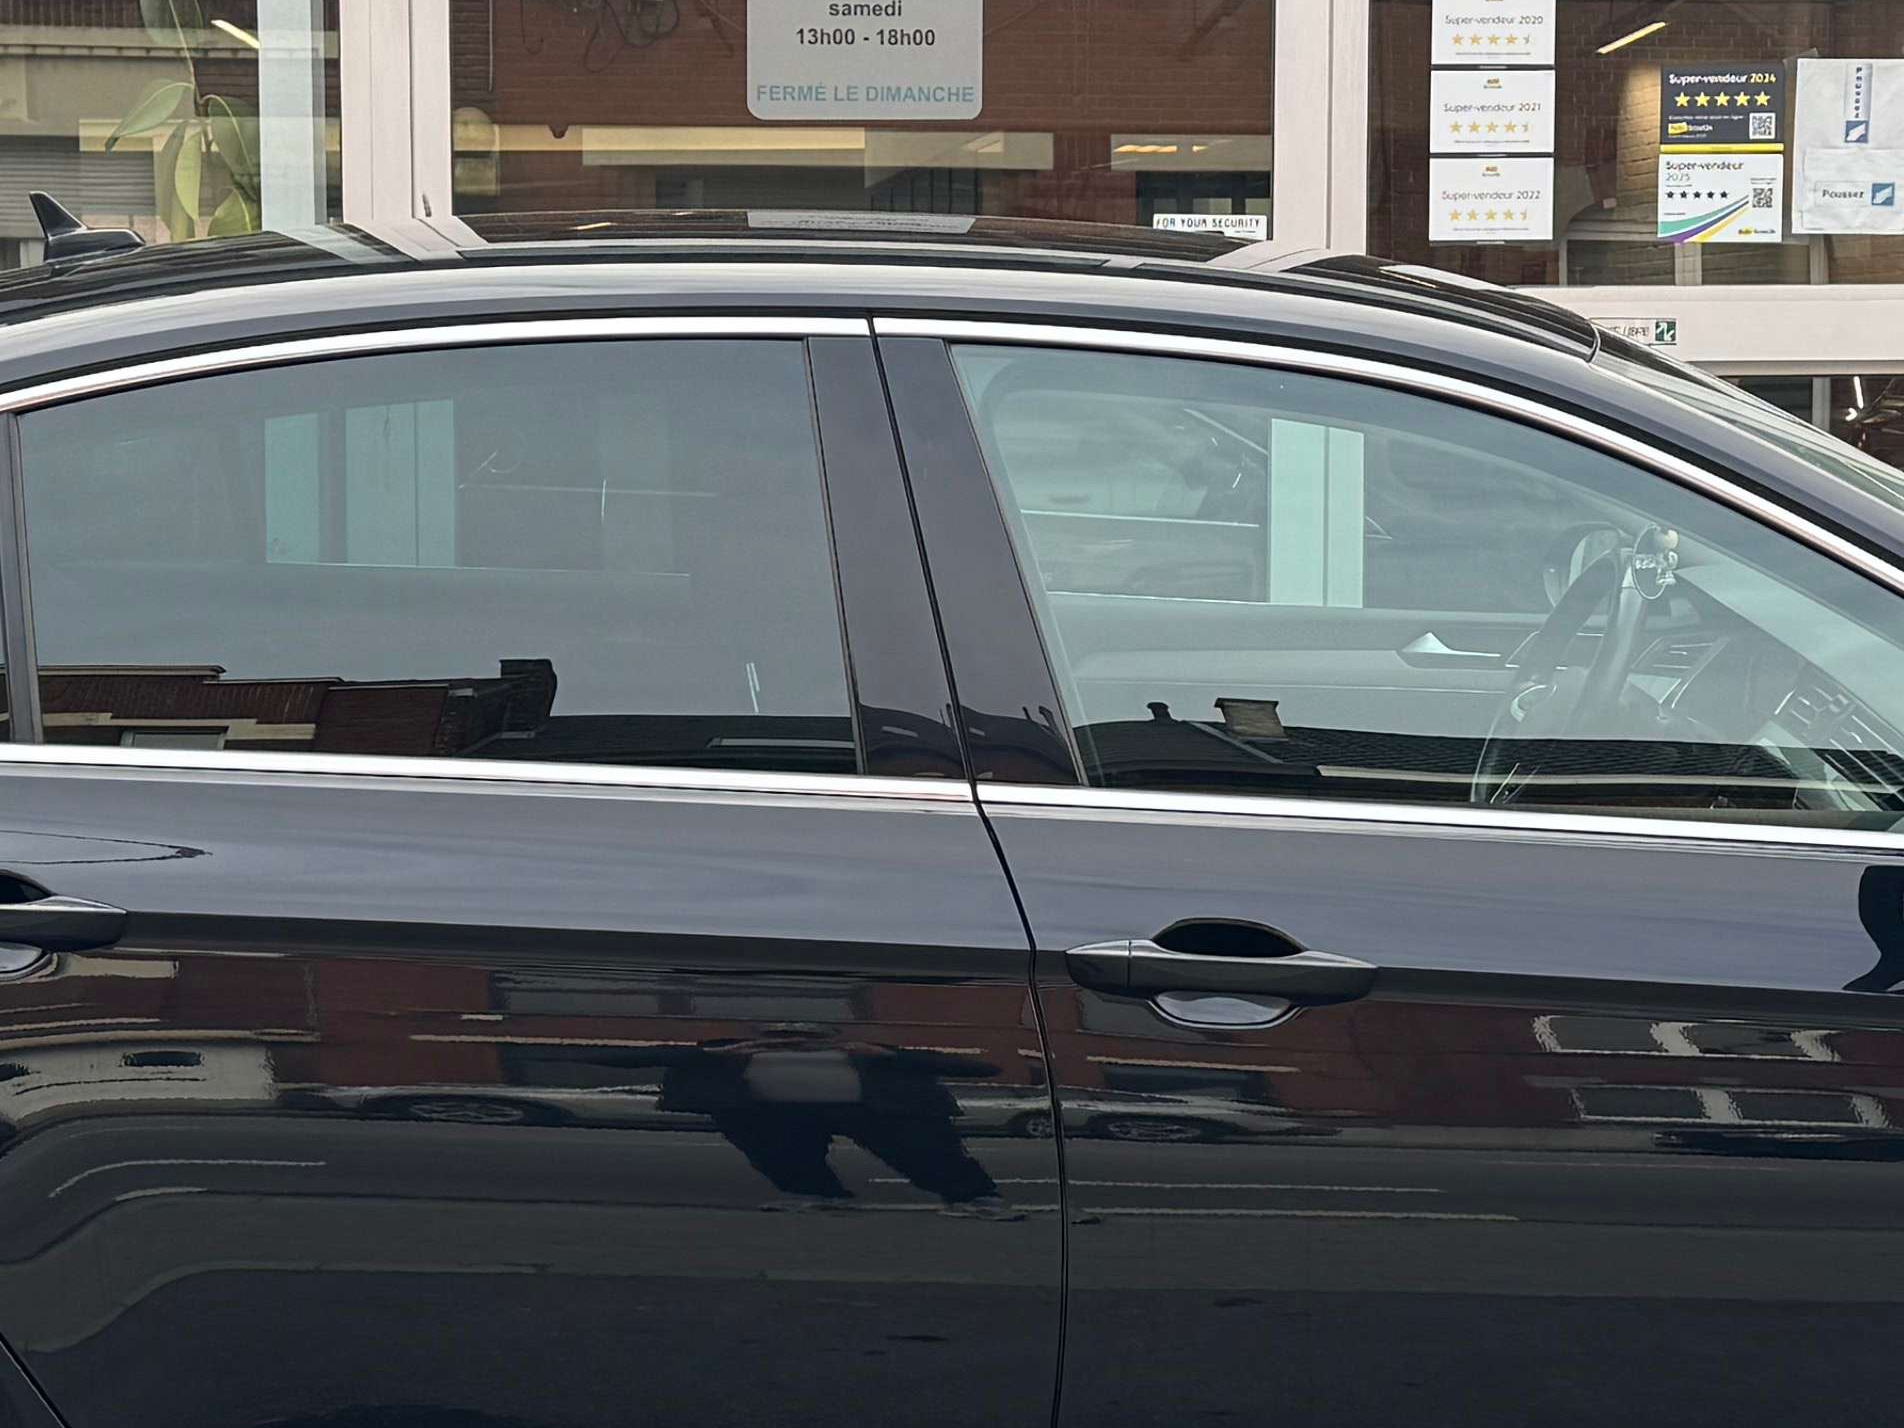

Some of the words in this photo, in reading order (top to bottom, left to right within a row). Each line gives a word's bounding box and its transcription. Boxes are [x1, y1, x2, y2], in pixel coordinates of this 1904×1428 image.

[828, 0, 903, 17] samedi
[796, 28, 856, 45] 13h00
[876, 29, 936, 46] 18h00
[834, 85, 858, 102] LE
[865, 85, 975, 103] DIMANCHE
[1181, 218, 1208, 229] YOUR
